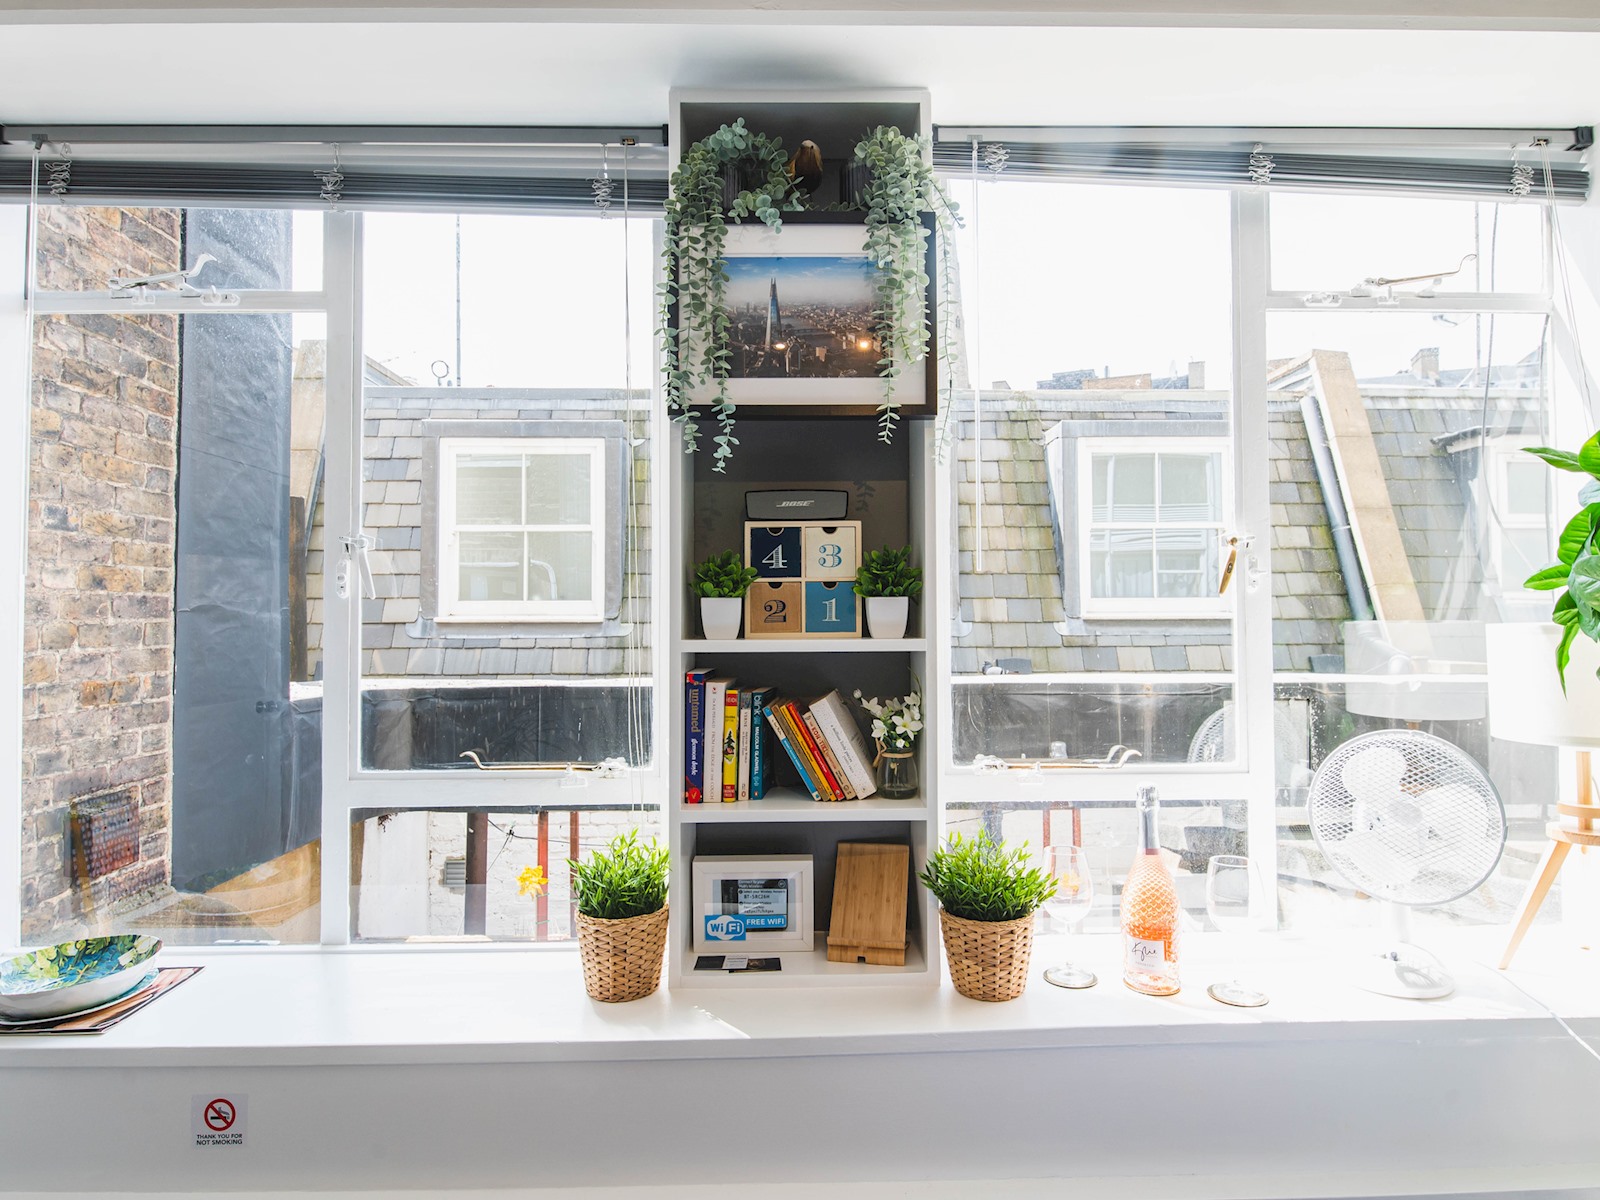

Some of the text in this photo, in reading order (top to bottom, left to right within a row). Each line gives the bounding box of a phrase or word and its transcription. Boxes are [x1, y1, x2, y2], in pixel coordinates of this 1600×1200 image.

[776, 500, 815, 508] BOSE
[762, 544, 788, 569] 4
[818, 543, 842, 568] 3
[764, 599, 787, 624] 2
[821, 598, 841, 622] 1
[691, 688, 701, 732] untamed
[754, 694, 762, 715] blink
